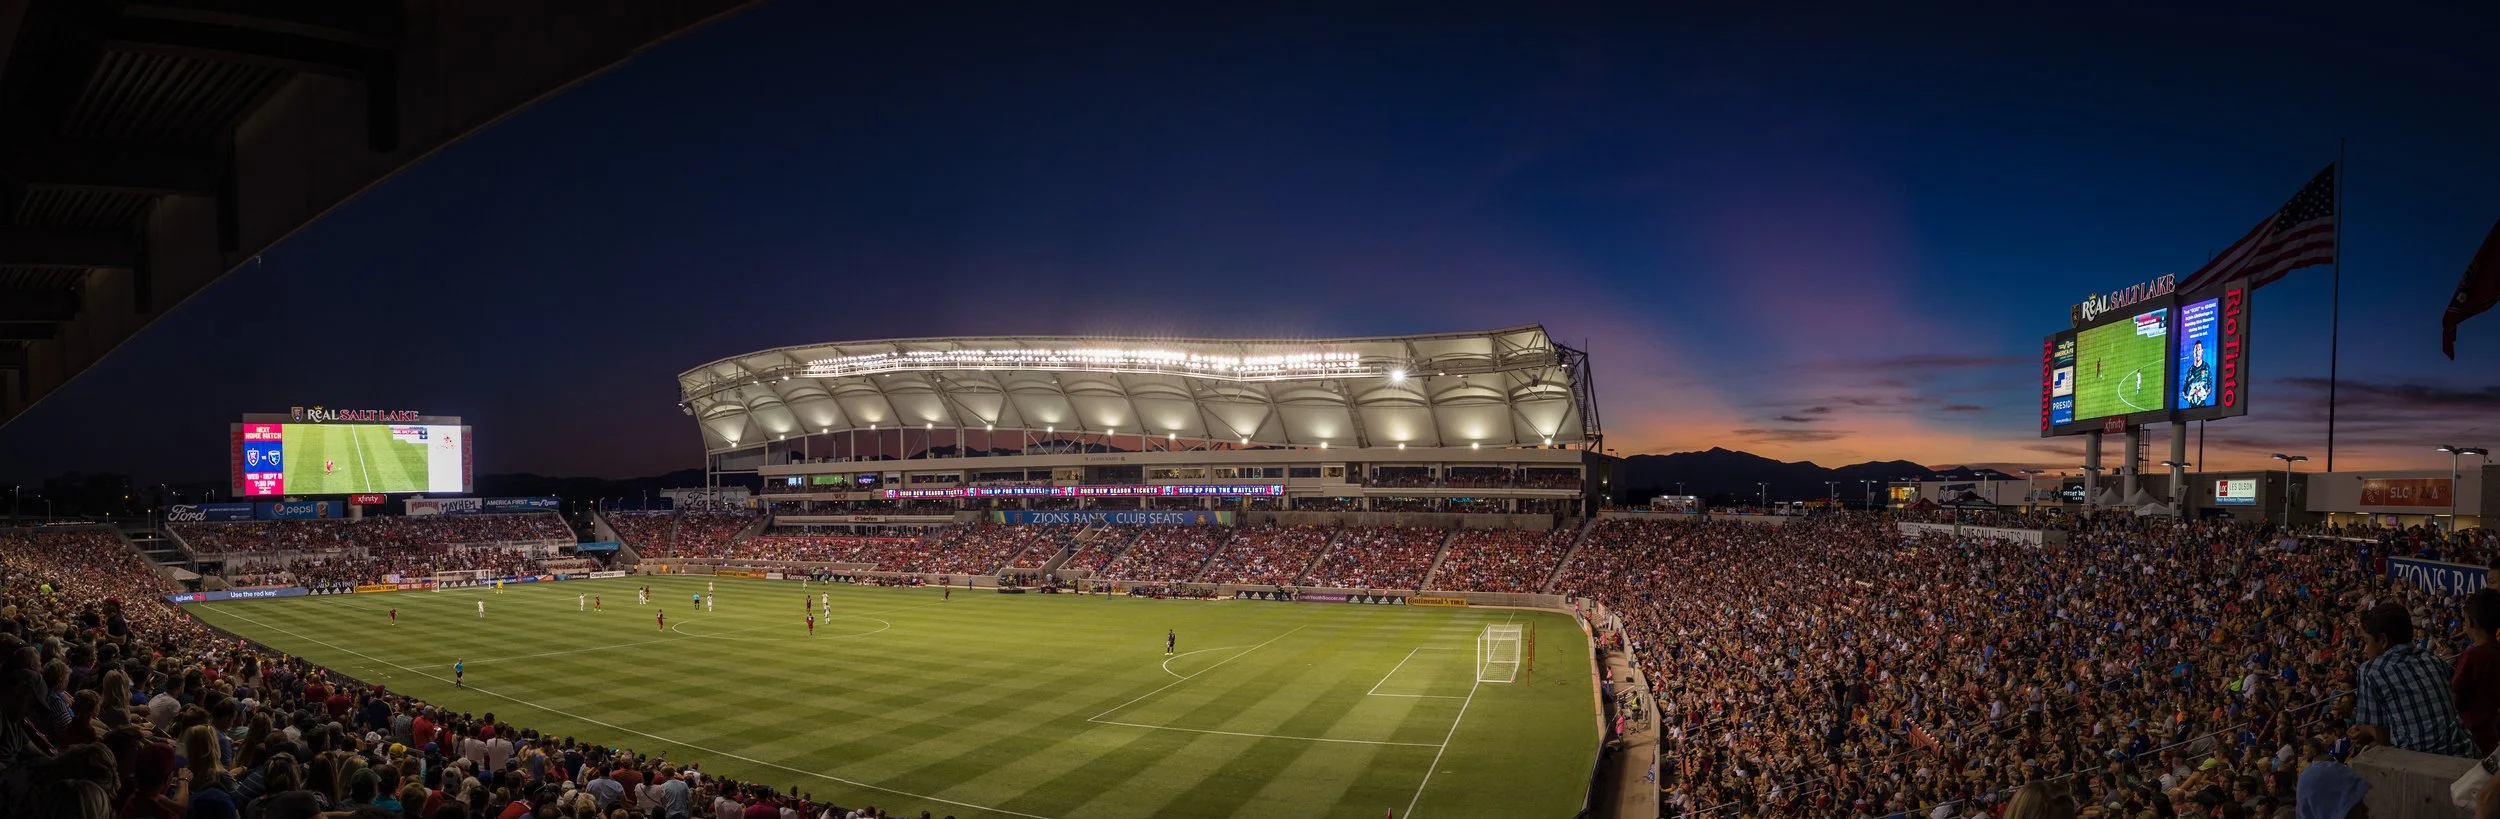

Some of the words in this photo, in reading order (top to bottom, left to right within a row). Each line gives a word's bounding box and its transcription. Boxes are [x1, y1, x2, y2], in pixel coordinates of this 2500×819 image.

[2110, 284, 2140, 310] SALT
[2140, 273, 2176, 302] LAKE
[340, 409, 378, 421] SALT
[378, 410, 420, 422] LAKE
[2104, 418, 2126, 431] xfinity
[2390, 487, 2408, 498] SLC
[358, 495, 379, 504] xfinity
[168, 504, 208, 522] Ford
[286, 504, 313, 516] pepsi
[412, 501, 439, 512] MAVERIK
[441, 500, 476, 514] MAYHEM
[1032, 513, 1069, 524] ZIONS
[1073, 513, 1108, 524] BANK
[1116, 513, 1145, 524] CLUB
[1150, 513, 1184, 524] SEATS
[2452, 570, 2488, 597] BA
